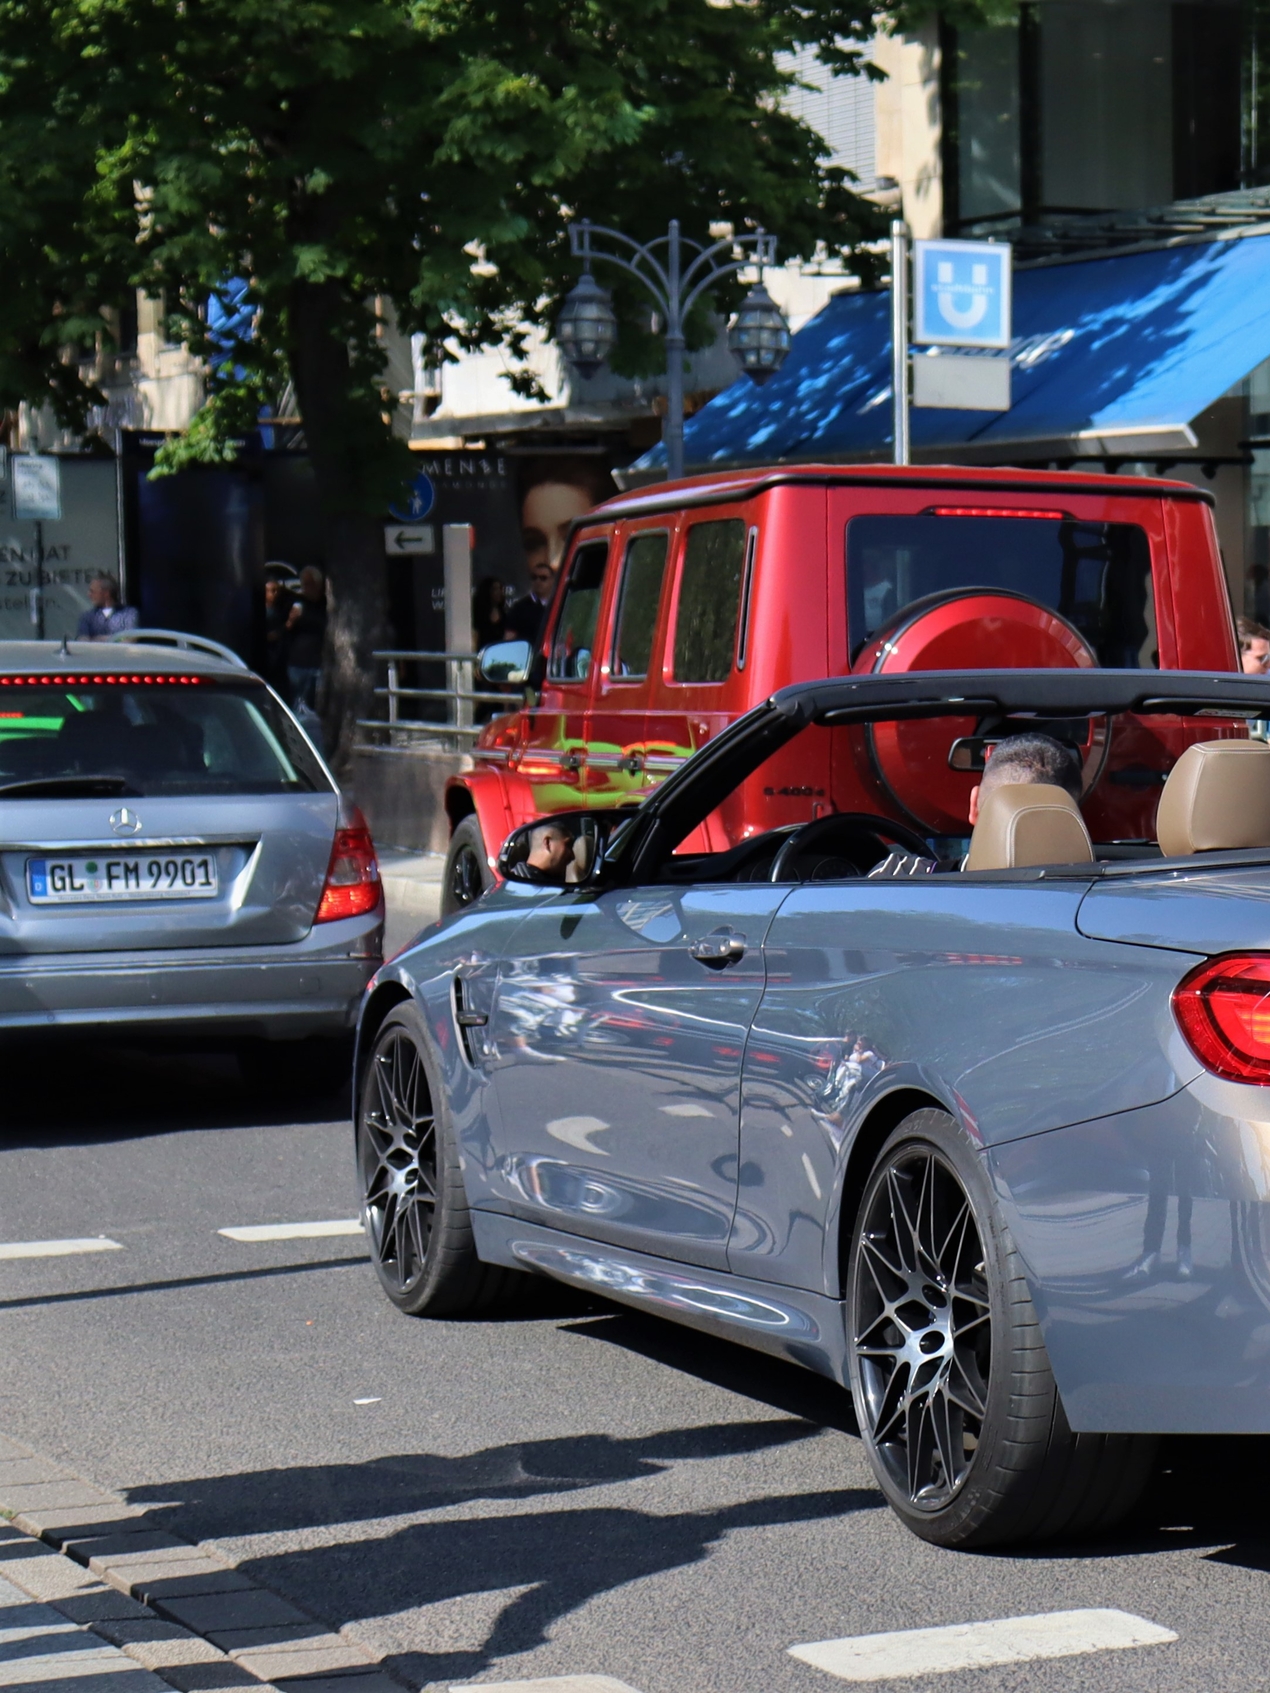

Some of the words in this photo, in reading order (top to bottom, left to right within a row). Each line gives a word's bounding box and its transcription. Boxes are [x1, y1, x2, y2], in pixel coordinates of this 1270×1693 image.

[34, 881, 42, 891] D
[50, 863, 85, 893] GL
[105, 860, 140, 890] FM
[147, 858, 212, 889] 9901
